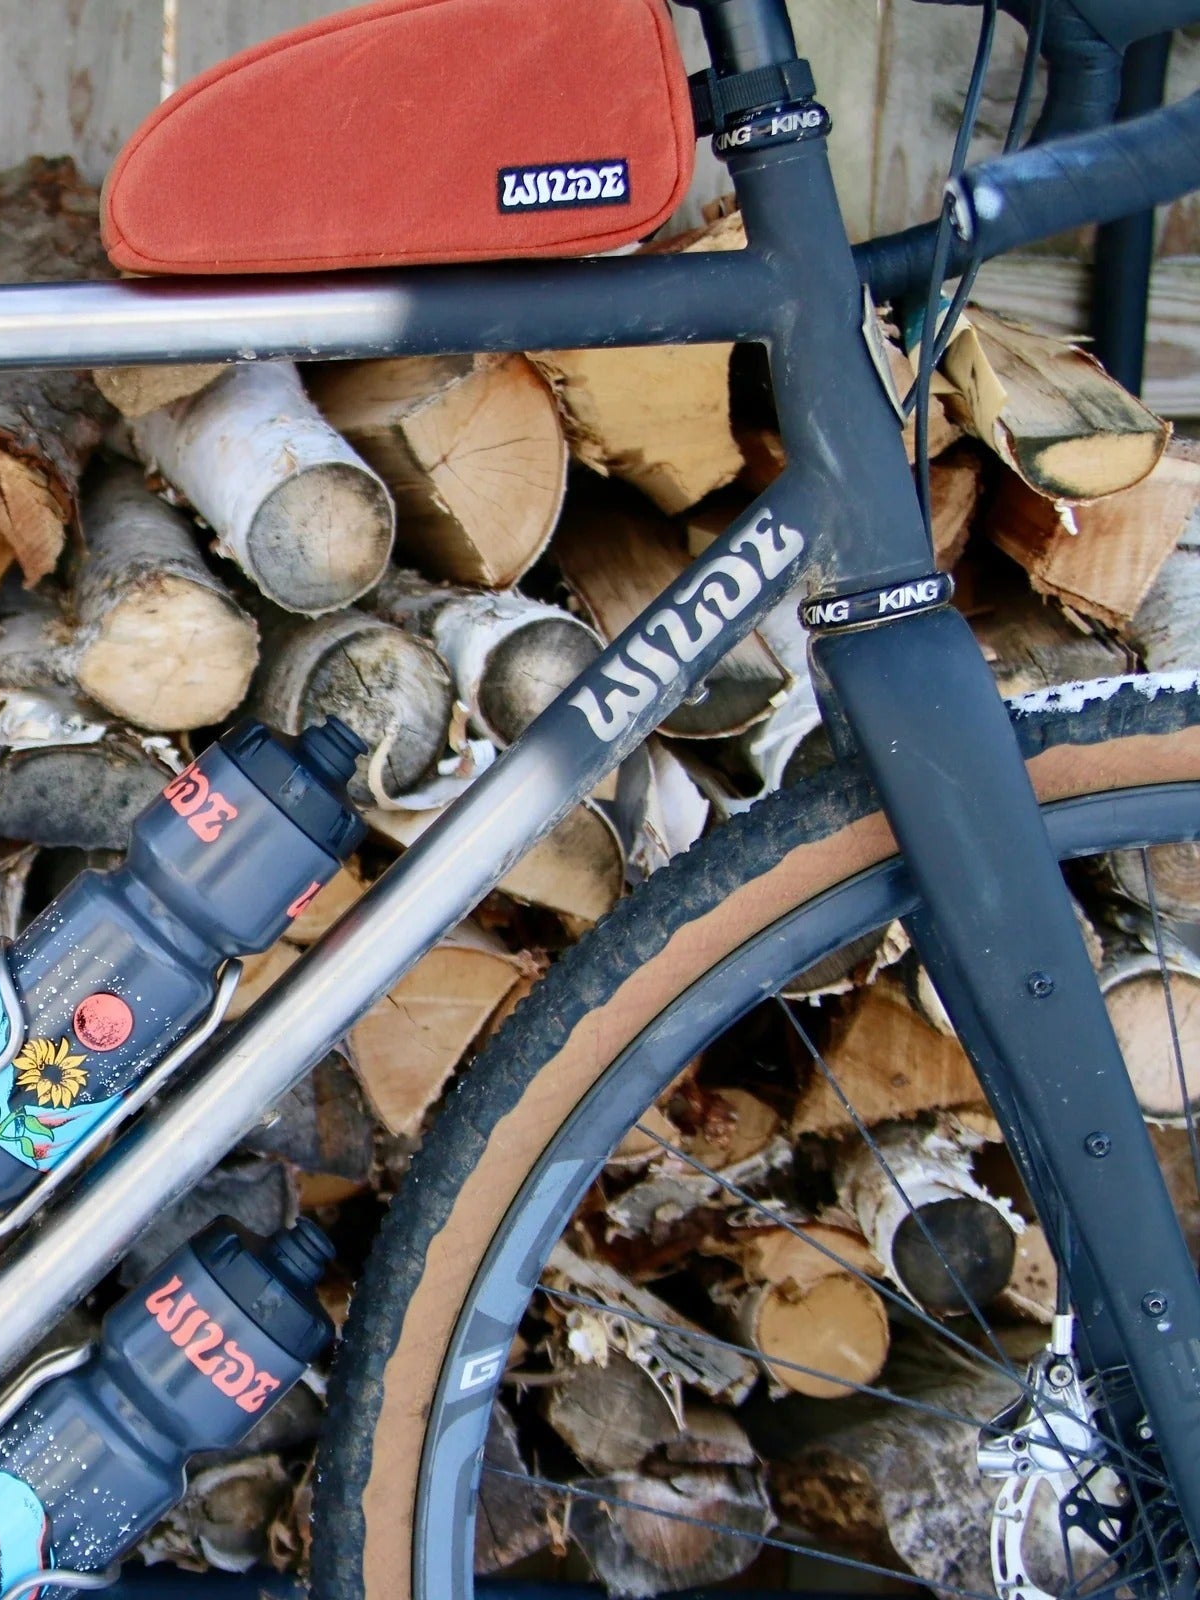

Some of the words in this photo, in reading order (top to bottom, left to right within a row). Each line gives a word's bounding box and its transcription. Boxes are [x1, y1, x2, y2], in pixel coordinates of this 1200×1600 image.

[770, 109, 822, 136] KING
[502, 166, 626, 206] WILDE
[568, 508, 804, 742] WILDE
[802, 600, 850, 626] KING
[877, 579, 938, 614] KING
[144, 1274, 281, 1414] WILDE
